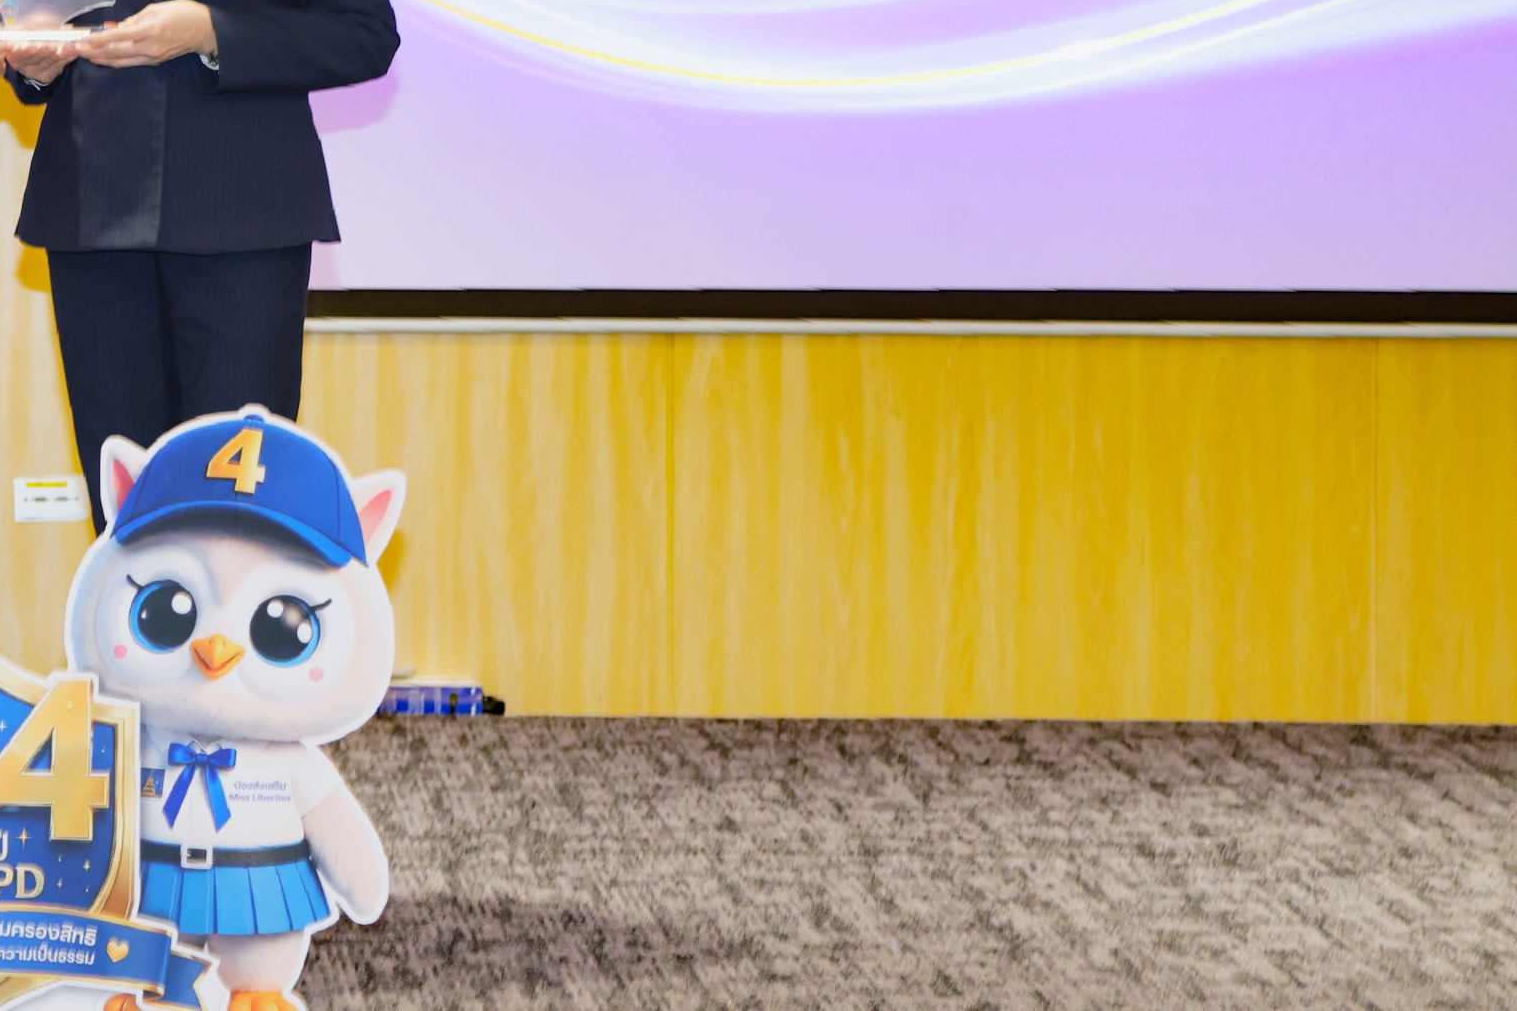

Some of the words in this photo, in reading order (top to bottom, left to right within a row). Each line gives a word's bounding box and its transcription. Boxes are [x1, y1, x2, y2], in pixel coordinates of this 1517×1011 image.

[206, 427, 266, 494] 4
[229, 793, 250, 802] Miss
[252, 794, 291, 802] Liberties
